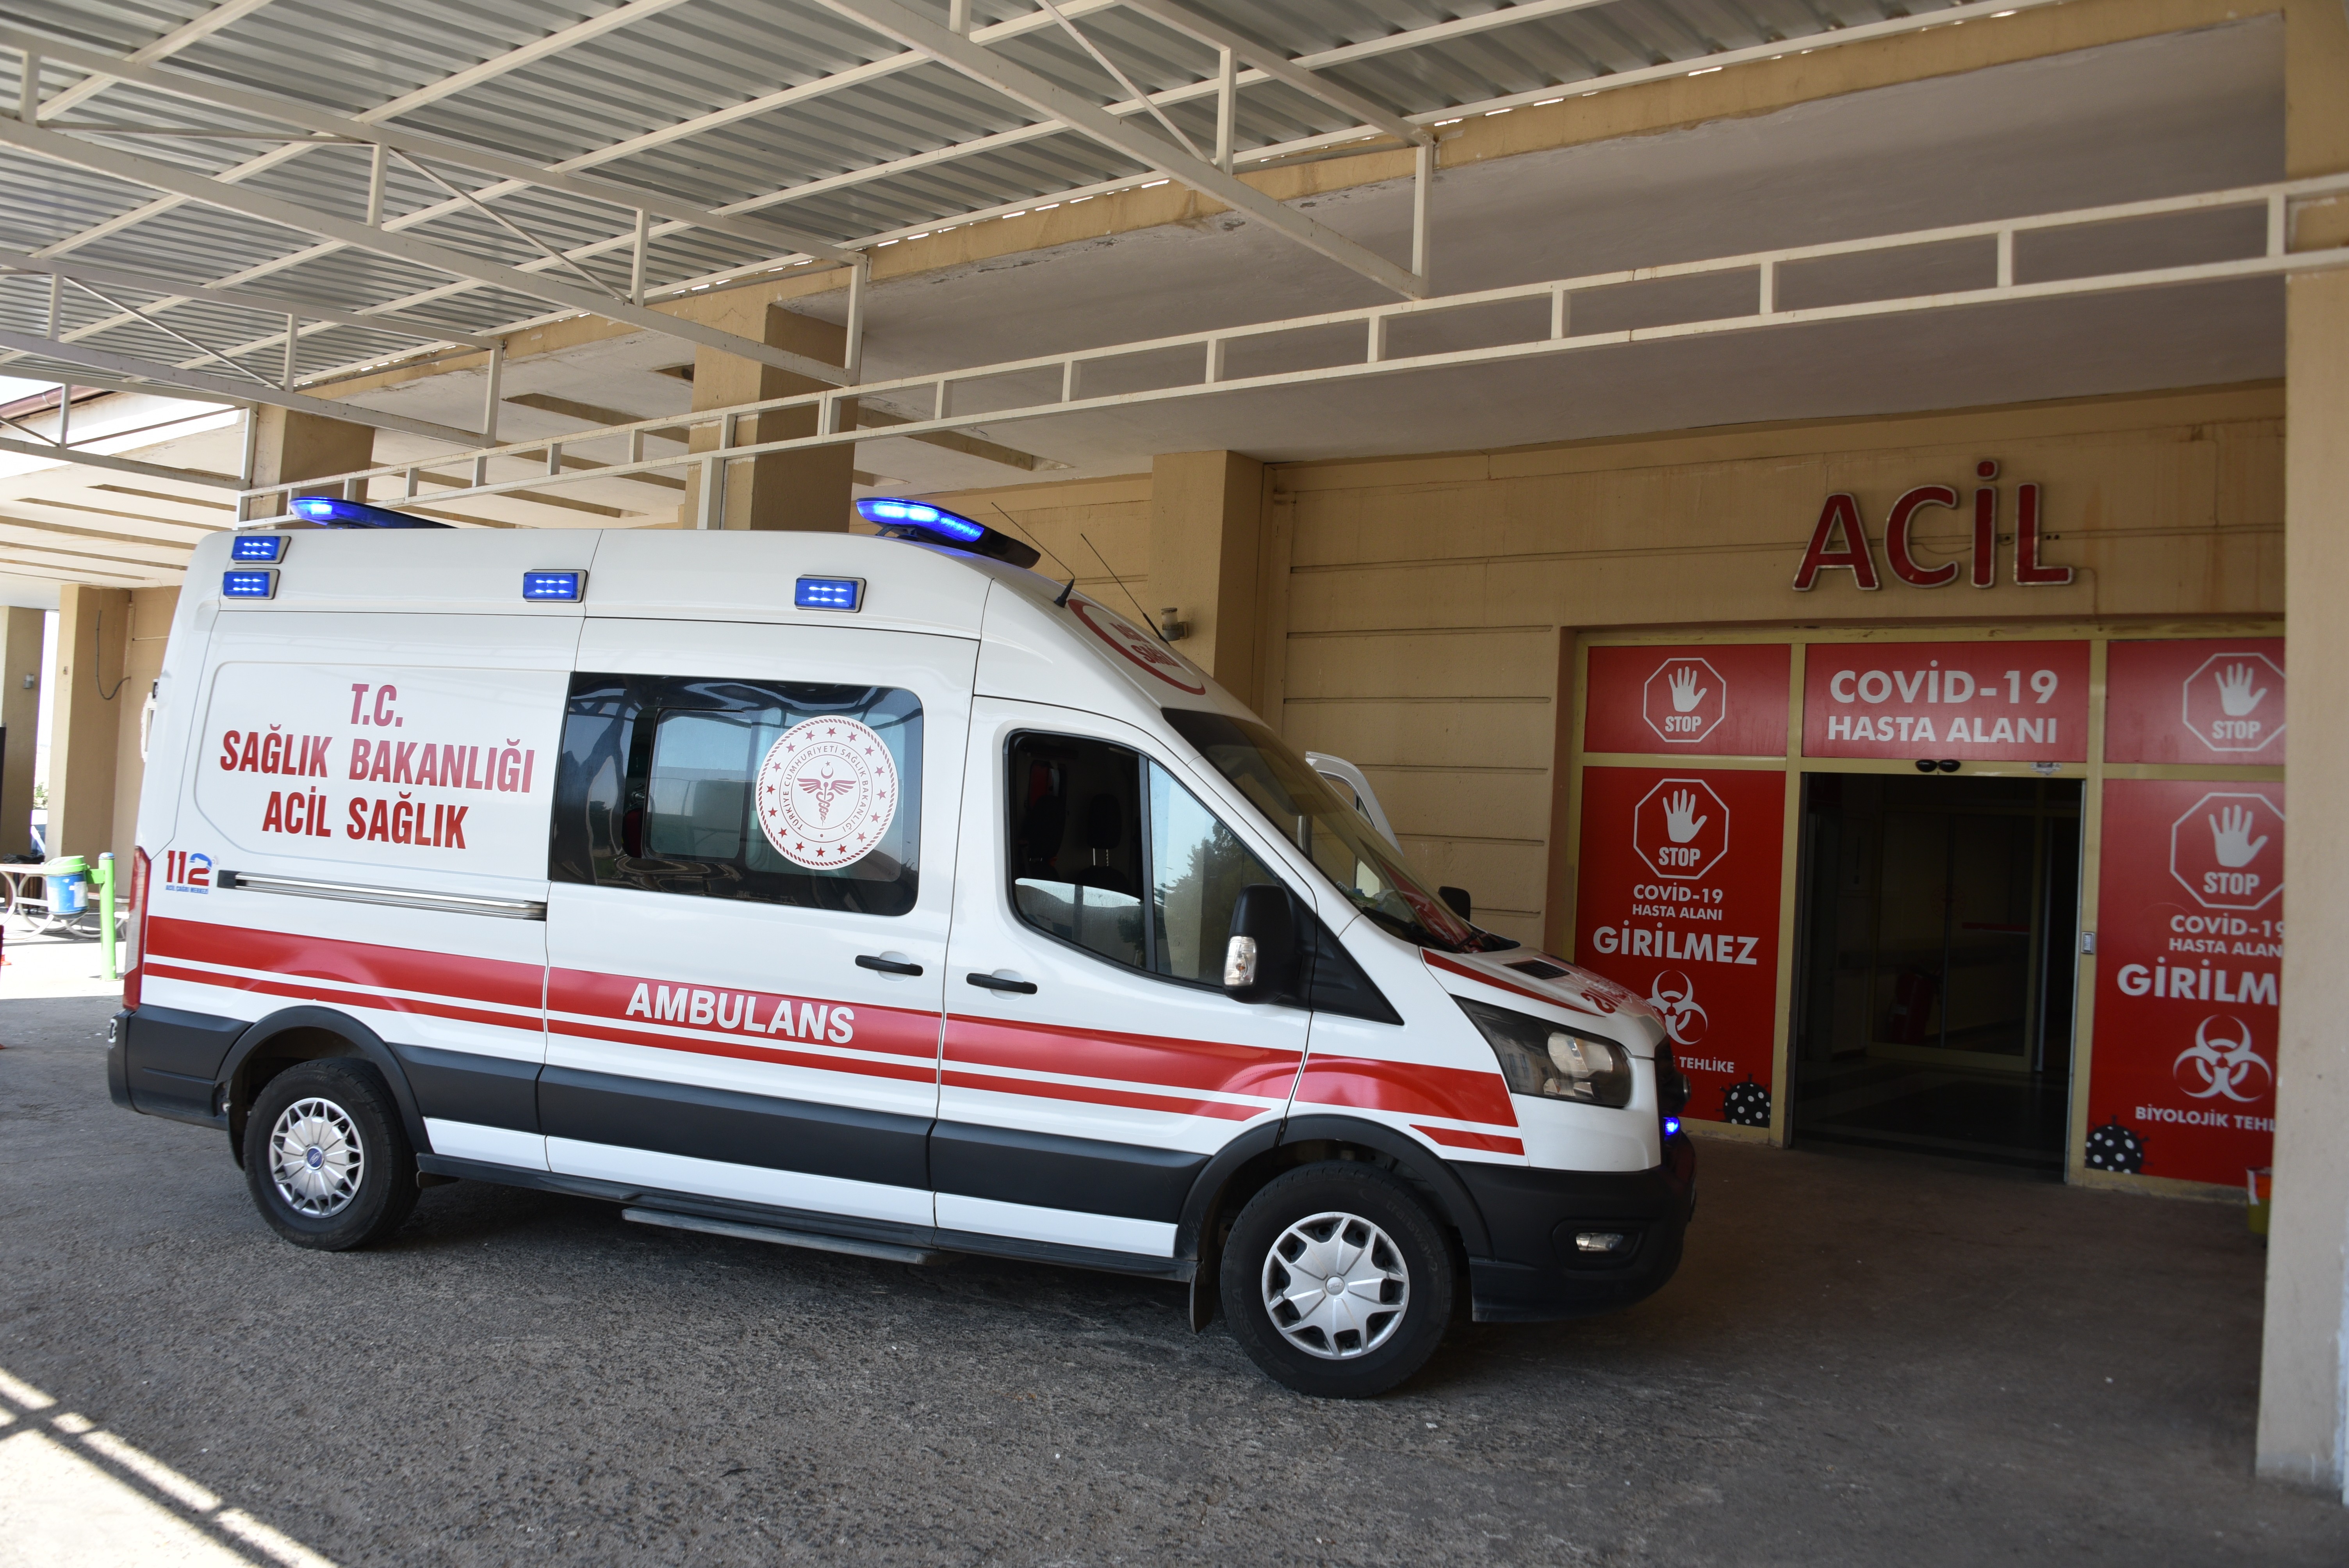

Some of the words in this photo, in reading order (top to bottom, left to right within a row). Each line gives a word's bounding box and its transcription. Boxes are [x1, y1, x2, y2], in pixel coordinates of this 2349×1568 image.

[1792, 459, 2074, 591] ACİL
[1830, 660, 2058, 704] COVİD-19
[351, 683, 403, 727] T.C.
[1665, 716, 1701, 732] STOP
[1828, 716, 1936, 742] HASTA
[1946, 717, 2057, 743] ALANI
[2212, 721, 2261, 739] STOP
[220, 723, 332, 778] SAĞLIK
[349, 738, 535, 793] BAKANLIĞI
[784, 745, 838, 787] CUMHURİYETİ
[840, 749, 866, 777] SAĞLIK
[262, 786, 331, 837] ACİL
[347, 791, 469, 849] SAĞLIK
[783, 791, 802, 831] TÜRKİYE
[843, 780, 869, 832] BAKANLIĞI
[167, 850, 212, 886] 112
[1659, 847, 1700, 867] STOP
[1633, 882, 1723, 903] COVİD-19
[2203, 871, 2260, 896] STOP
[1632, 904, 1676, 918] HASTA
[1679, 907, 1722, 921] ALANI
[1593, 919, 1759, 965] GİRİLMEZ
[2169, 937, 2227, 954] HASTA
[2231, 941, 2283, 958] ALAN
[2117, 956, 2278, 1006] GİRİLM
[626, 983, 854, 1044] AMBULANS
[1679, 1057, 1734, 1073] TEHLİKE
[2135, 1104, 2228, 1127] BİYOLOJİK
[2233, 1115, 2276, 1131] TEHL
